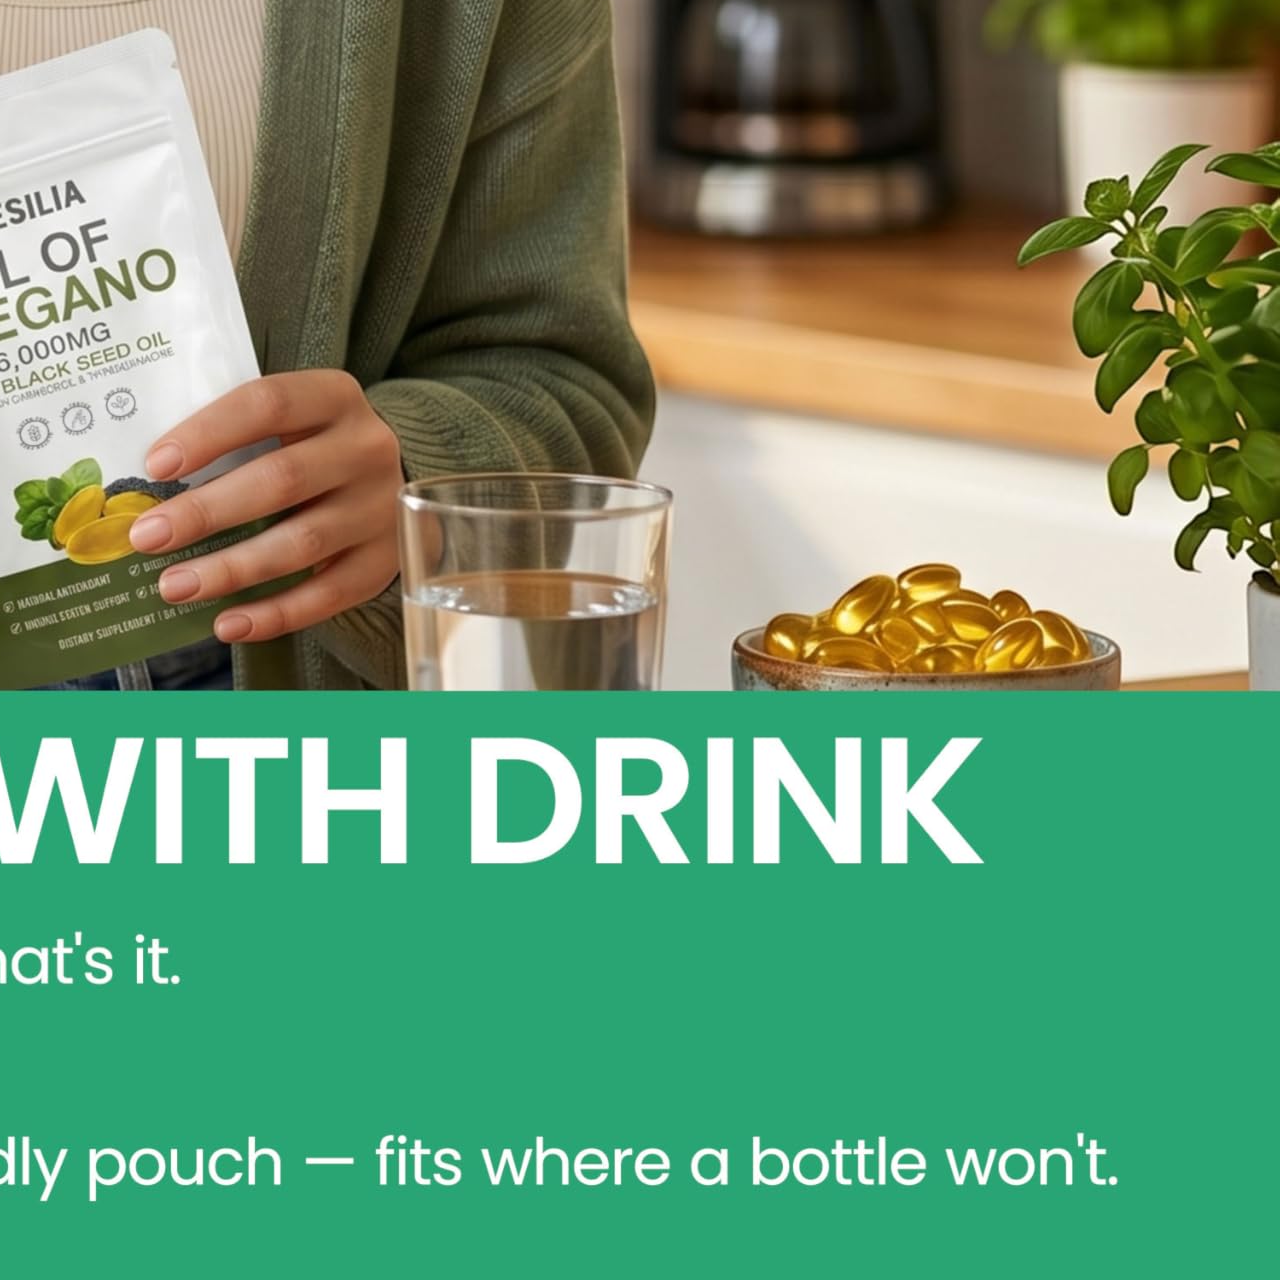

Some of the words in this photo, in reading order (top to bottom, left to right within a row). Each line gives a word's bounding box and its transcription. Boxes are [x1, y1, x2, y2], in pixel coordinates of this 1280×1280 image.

[40, 219, 109, 273] OF
[1, 360, 71, 394] BLACK
[76, 343, 131, 371] SEED
[136, 331, 171, 352] OIL
